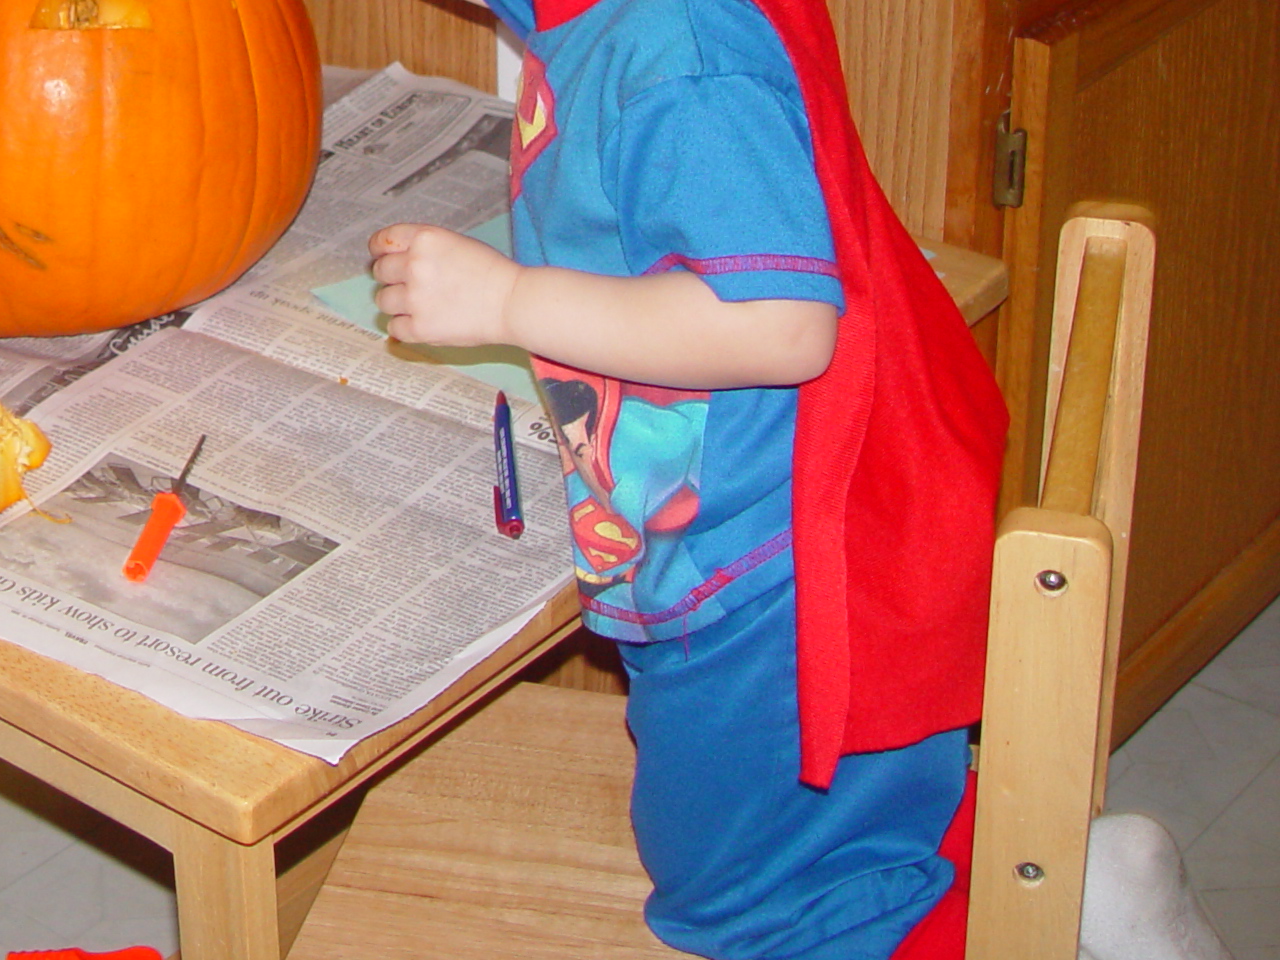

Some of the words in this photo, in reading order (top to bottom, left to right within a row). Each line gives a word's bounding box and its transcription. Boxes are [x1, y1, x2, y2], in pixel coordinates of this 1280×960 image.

[15, 586, 61, 612] kids
[56, 604, 116, 631] show
[111, 625, 138, 644] to
[134, 634, 202, 667] resort
[201, 661, 255, 691] from
[250, 684, 294, 707] out
[294, 703, 363, 729] Strike
